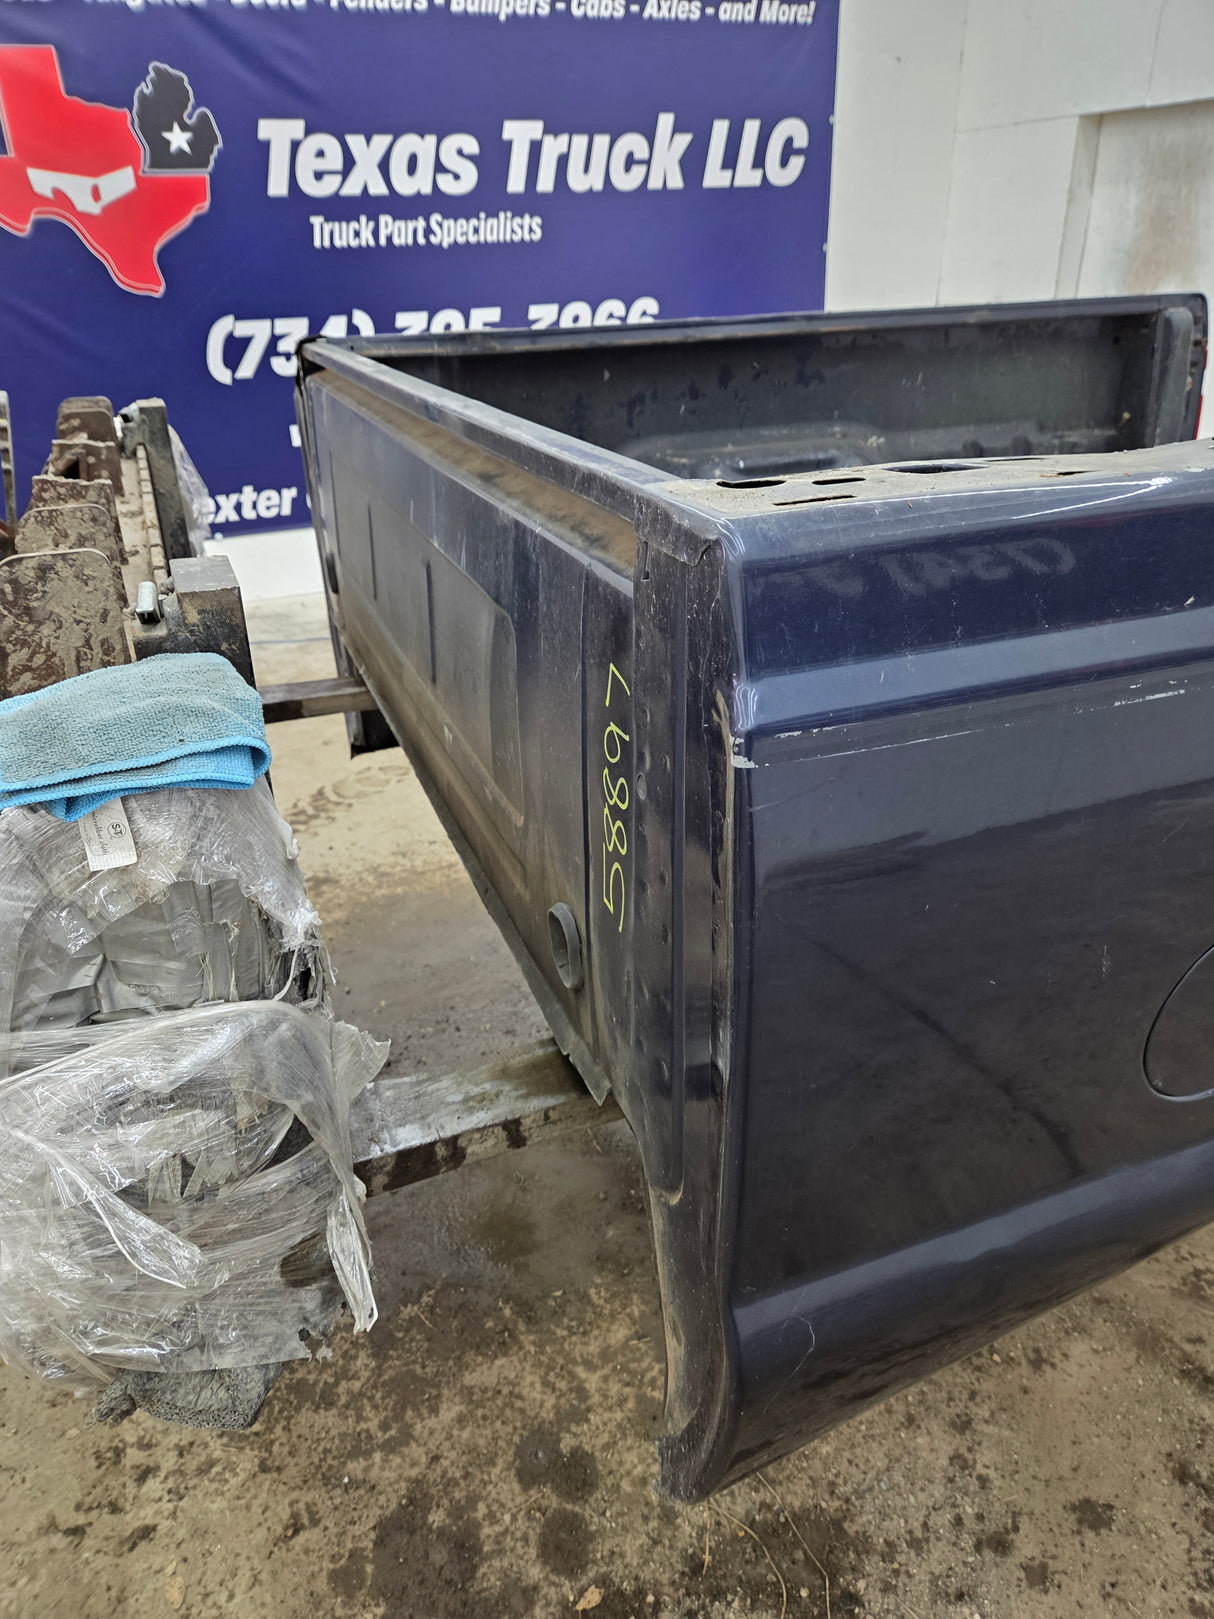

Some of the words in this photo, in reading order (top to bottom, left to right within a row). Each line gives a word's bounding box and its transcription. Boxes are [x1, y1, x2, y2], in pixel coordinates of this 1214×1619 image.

[450, 0, 550, 22] Bumpers
[570, 0, 626, 19] Cabs
[642, 0, 702, 20] Axles
[718, 1, 757, 23] and
[759, 1, 816, 24] More!
[257, 118, 480, 198] Texas
[501, 112, 694, 194] Truck
[702, 117, 810, 189] LLC
[309, 214, 376, 249] Truck
[378, 213, 427, 247] Part
[428, 211, 543, 249] Specialists
